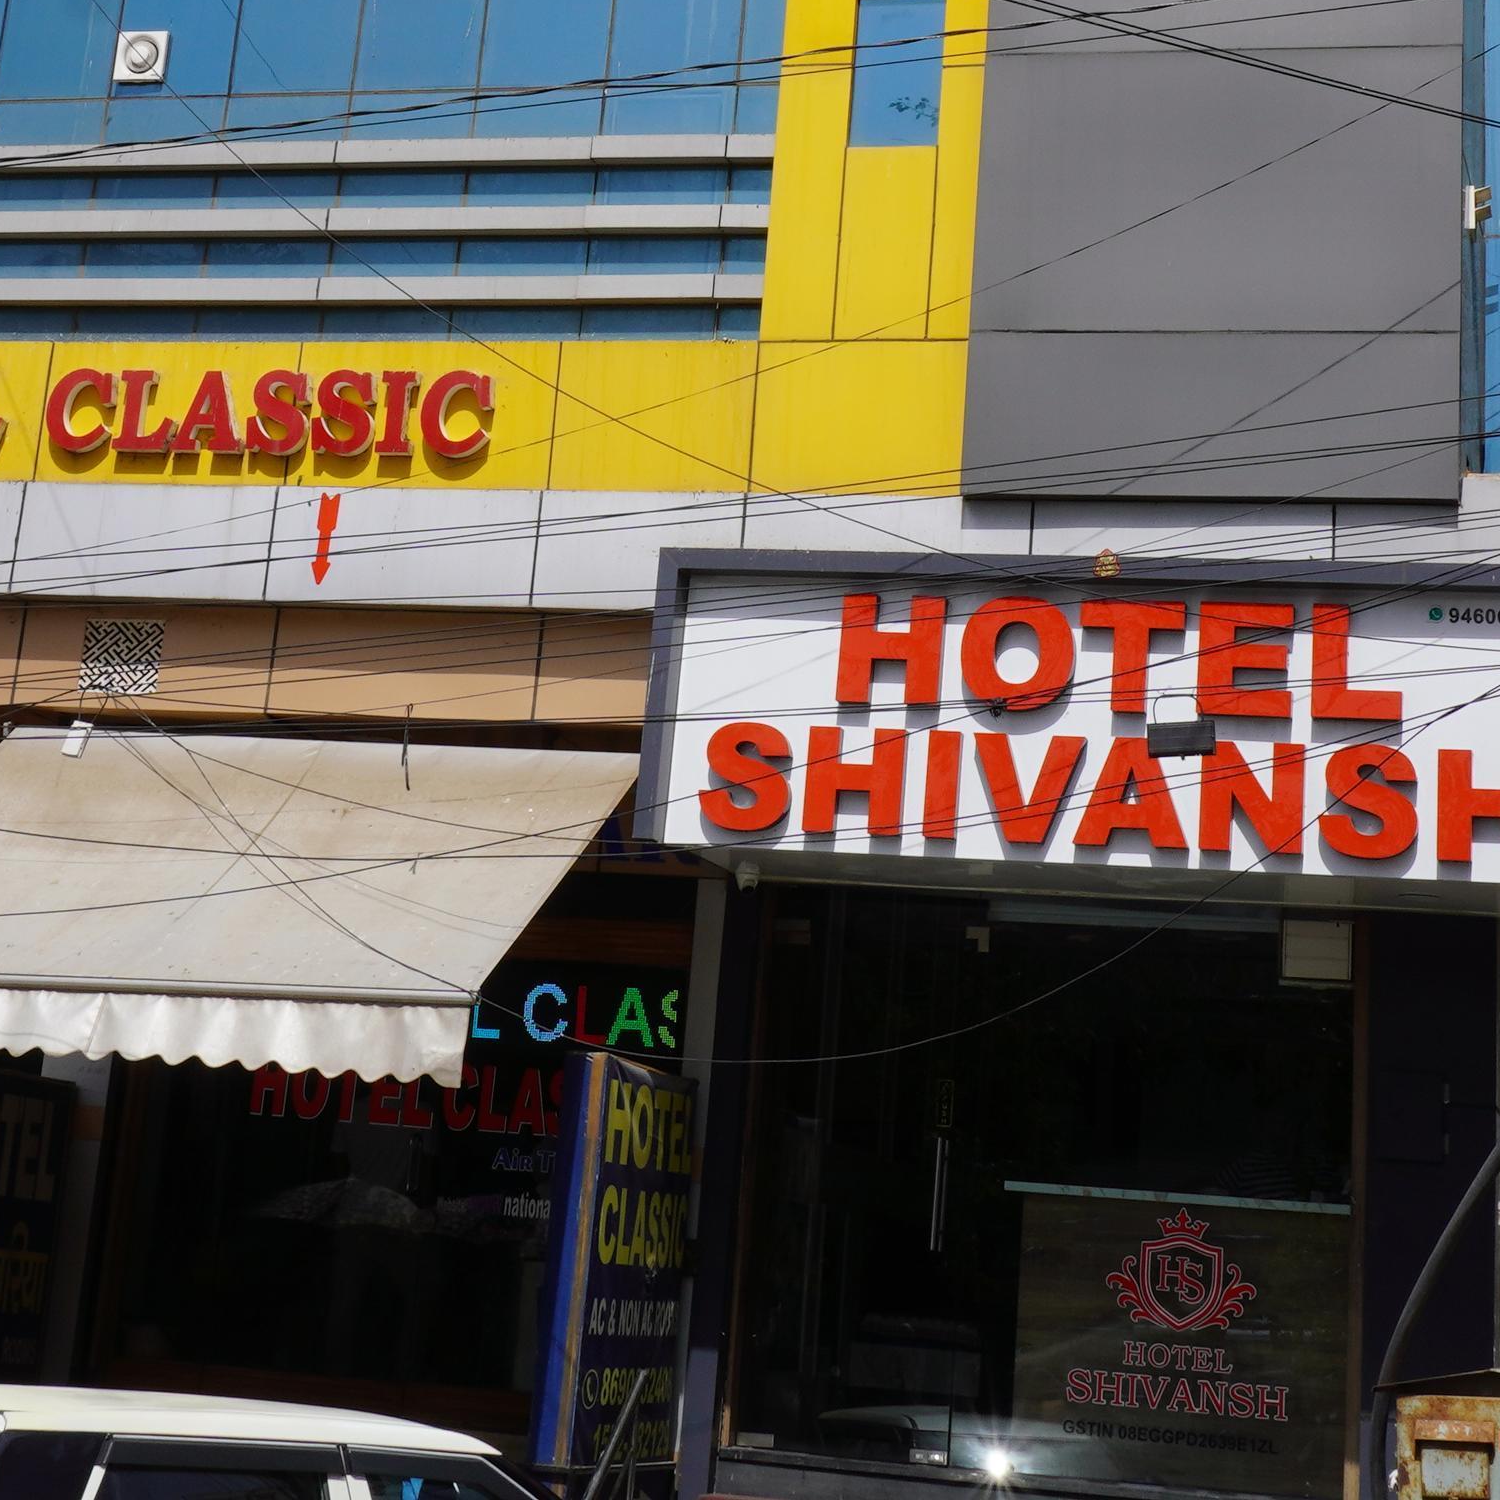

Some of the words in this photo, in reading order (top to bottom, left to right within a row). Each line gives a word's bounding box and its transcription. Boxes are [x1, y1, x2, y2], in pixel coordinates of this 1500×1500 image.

[47, 367, 496, 460] CLASSIC
[834, 592, 1404, 722] HOTEL
[604, 1077, 694, 1177] HOTEL
[502, 1190, 552, 1221] nationa
[597, 1183, 688, 1270] CLASSIC
[588, 1297, 607, 1336] AC
[618, 1299, 642, 1338] NON
[1122, 1340, 1234, 1375] HOTEL
[1065, 1367, 1290, 1422] SHIVANSH
[1062, 1419, 1114, 1440] GSTIN
